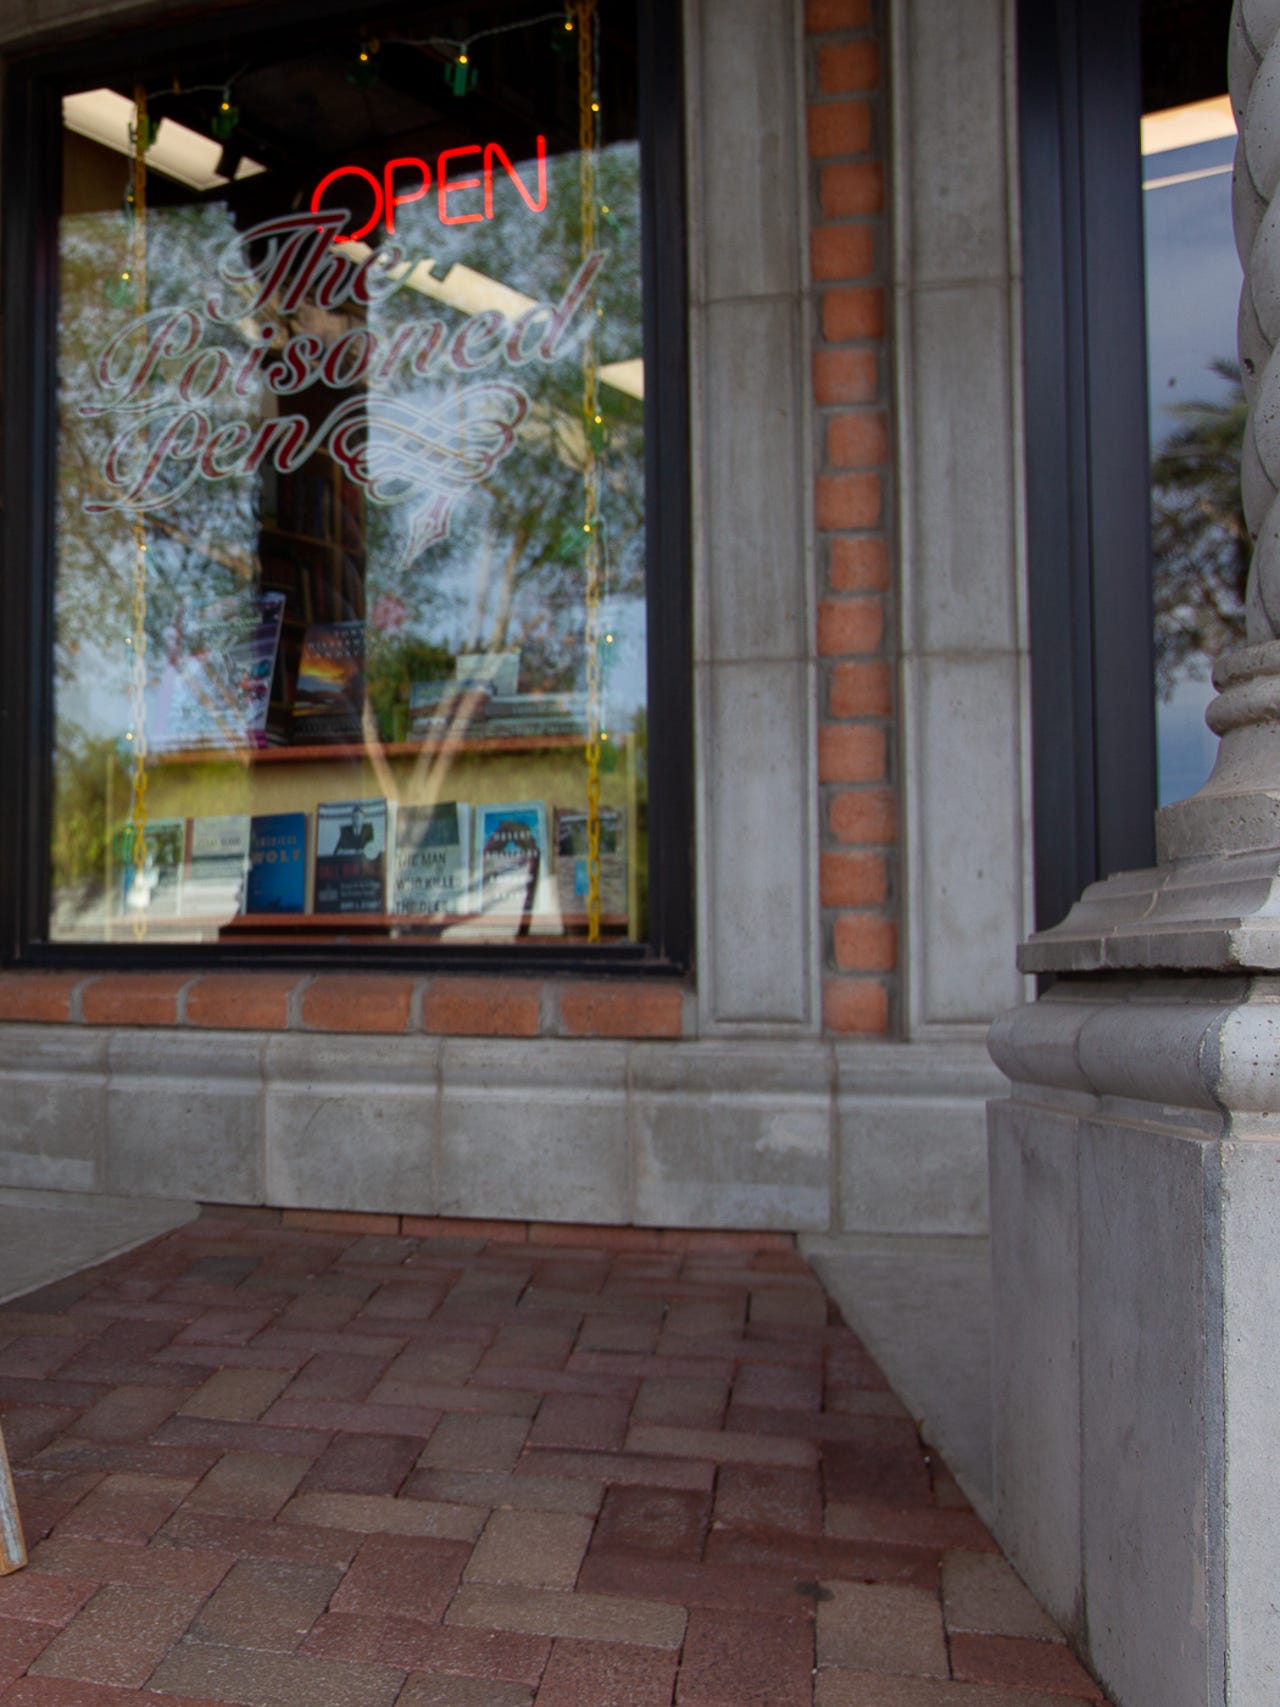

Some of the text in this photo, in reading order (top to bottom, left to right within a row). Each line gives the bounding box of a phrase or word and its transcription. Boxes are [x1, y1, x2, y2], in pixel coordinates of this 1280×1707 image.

[310, 134, 546, 243] OPEN
[205, 209, 411, 323] The
[78, 248, 608, 415] Poisoned
[83, 398, 310, 514] Pen
